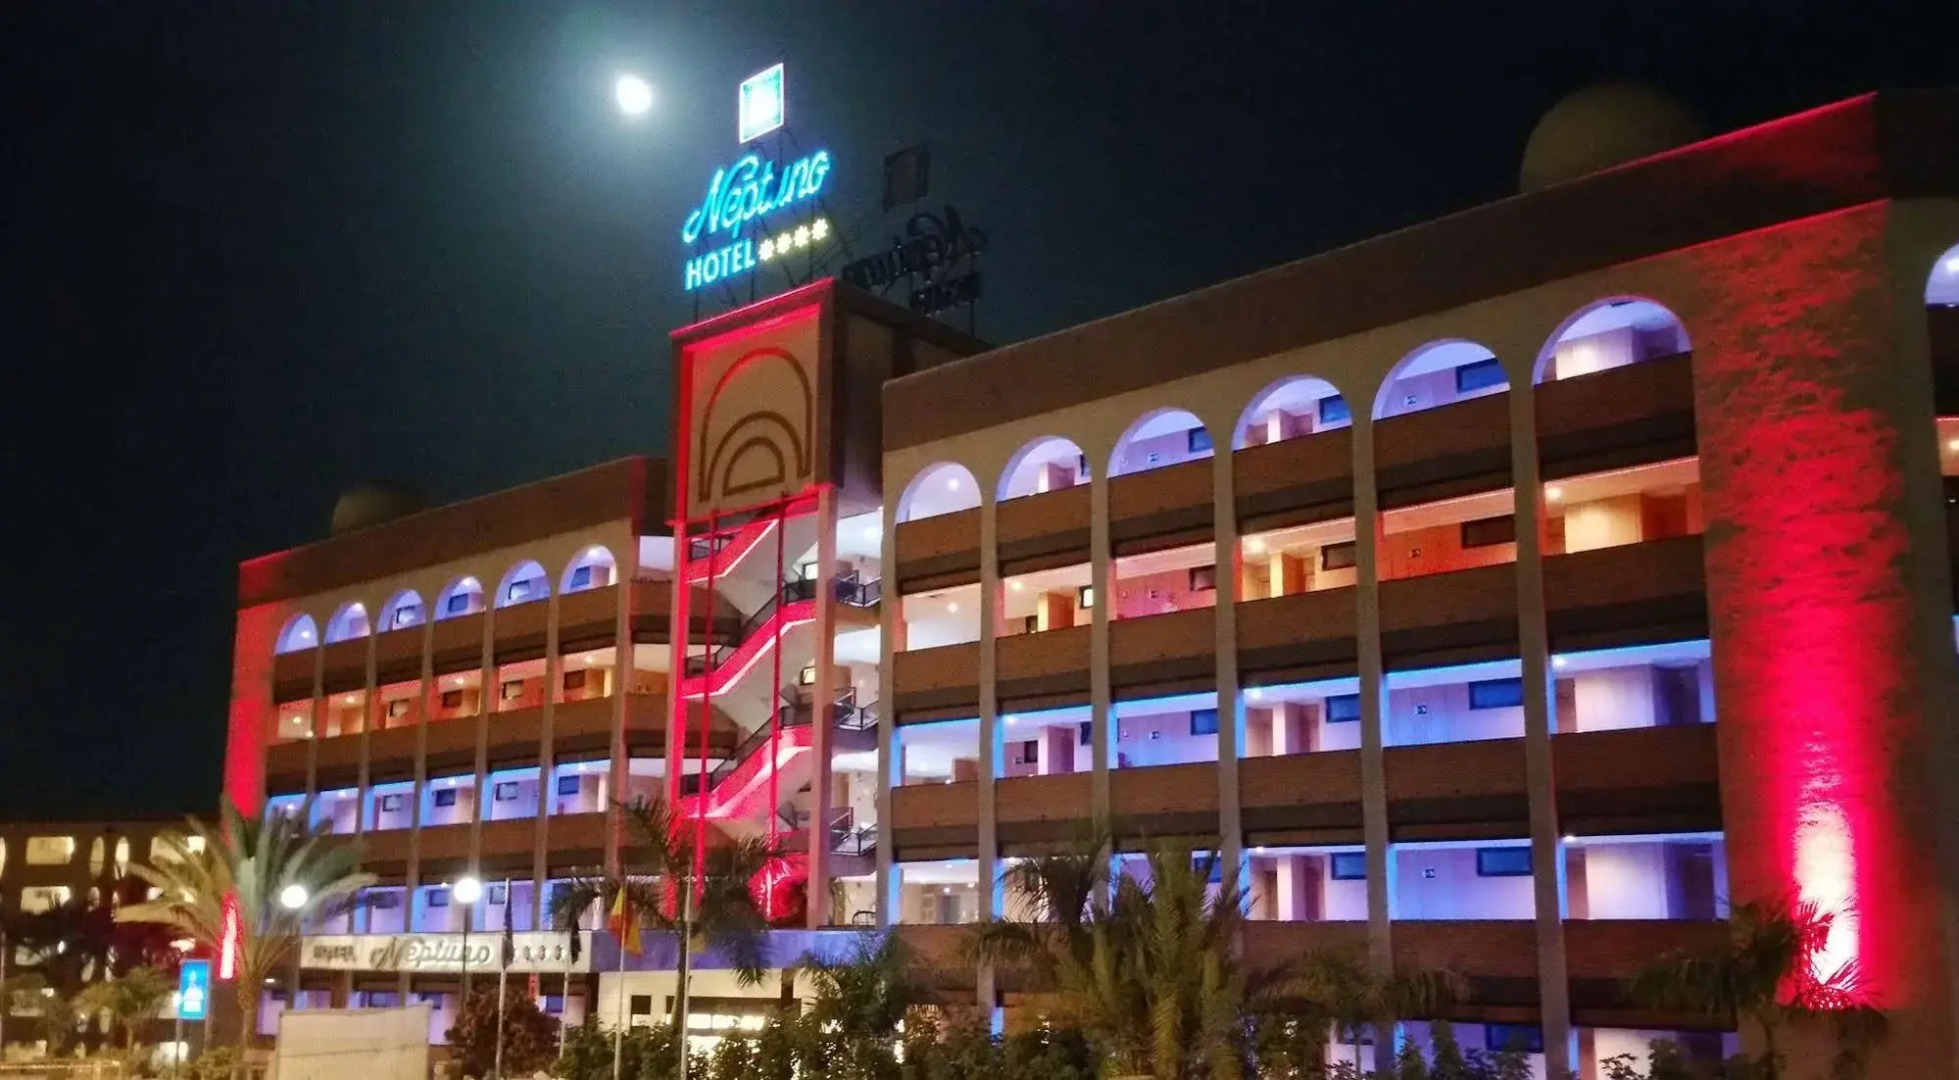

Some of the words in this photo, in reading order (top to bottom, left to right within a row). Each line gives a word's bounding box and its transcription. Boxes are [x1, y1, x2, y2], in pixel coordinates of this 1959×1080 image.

[682, 151, 830, 243] Neptuno
[685, 238, 756, 291] HOTEL
[368, 935, 492, 970] Neptuno
